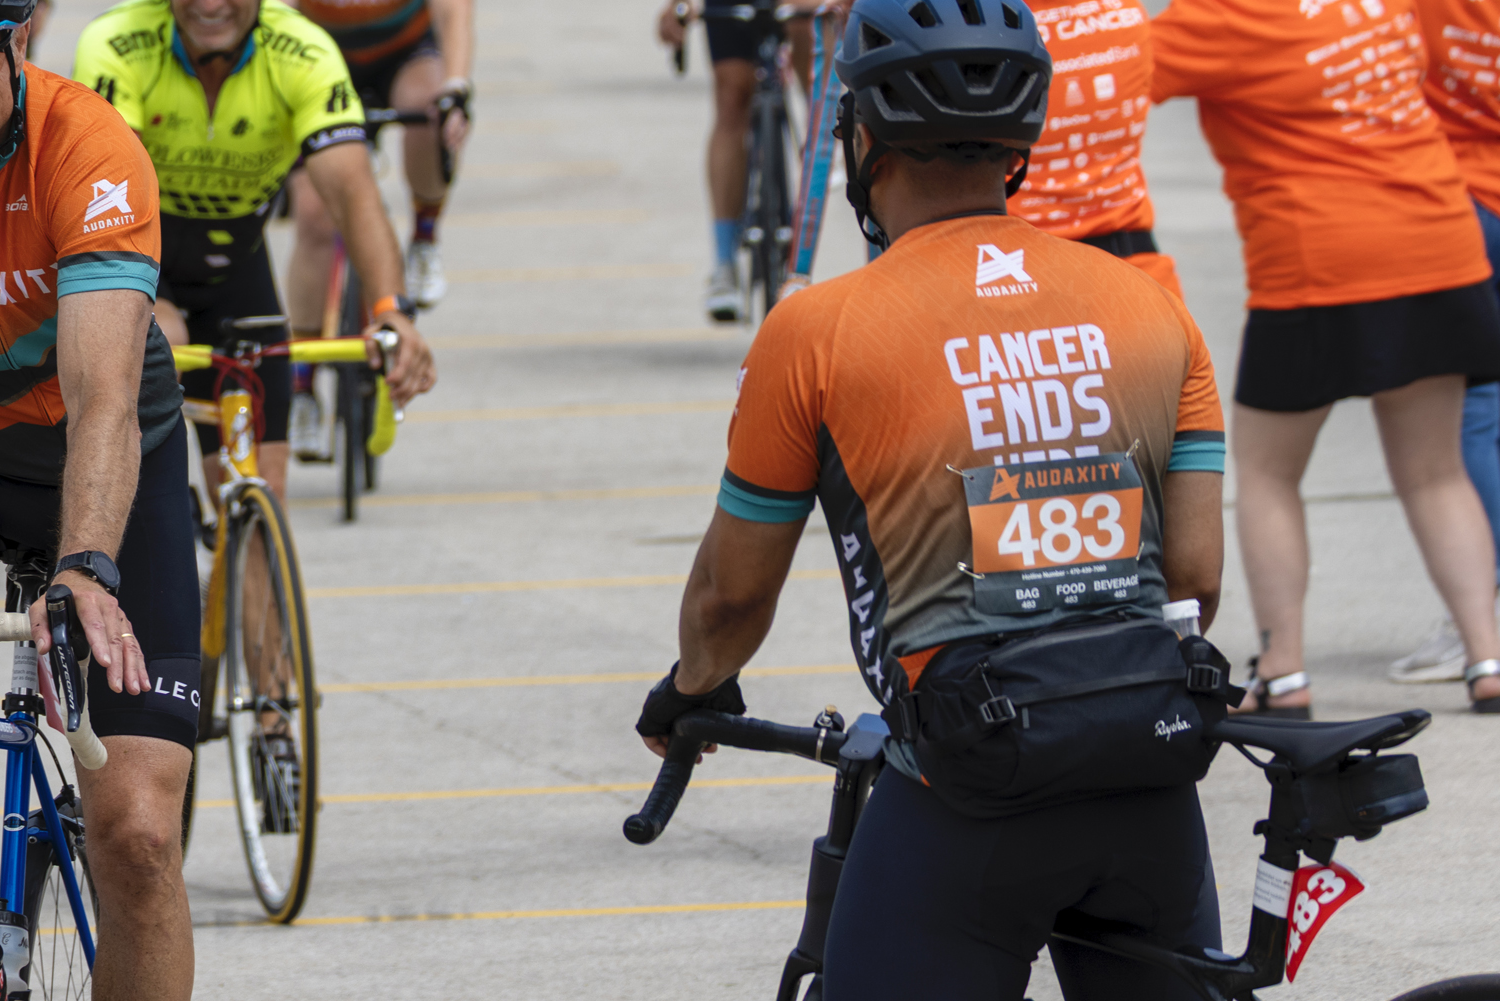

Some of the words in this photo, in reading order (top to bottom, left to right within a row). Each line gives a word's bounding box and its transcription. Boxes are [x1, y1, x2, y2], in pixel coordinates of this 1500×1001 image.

[1056, 7, 1144, 40] CANCER
[83, 214, 135, 234] AUDAXITY
[975, 282, 1039, 298] AUDAXITY
[943, 323, 1112, 386] CANCER
[962, 373, 1112, 451] ENDS
[1024, 461, 1122, 490] AUDAXITY
[997, 492, 1126, 567] 483
[1015, 587, 1040, 600] BAG
[1056, 582, 1086, 595] FOOD
[1021, 600, 1036, 610] 483
[1064, 595, 1079, 604] 483
[1113, 588, 1127, 598] 483
[57, 645, 75, 710] ULTEGRA
